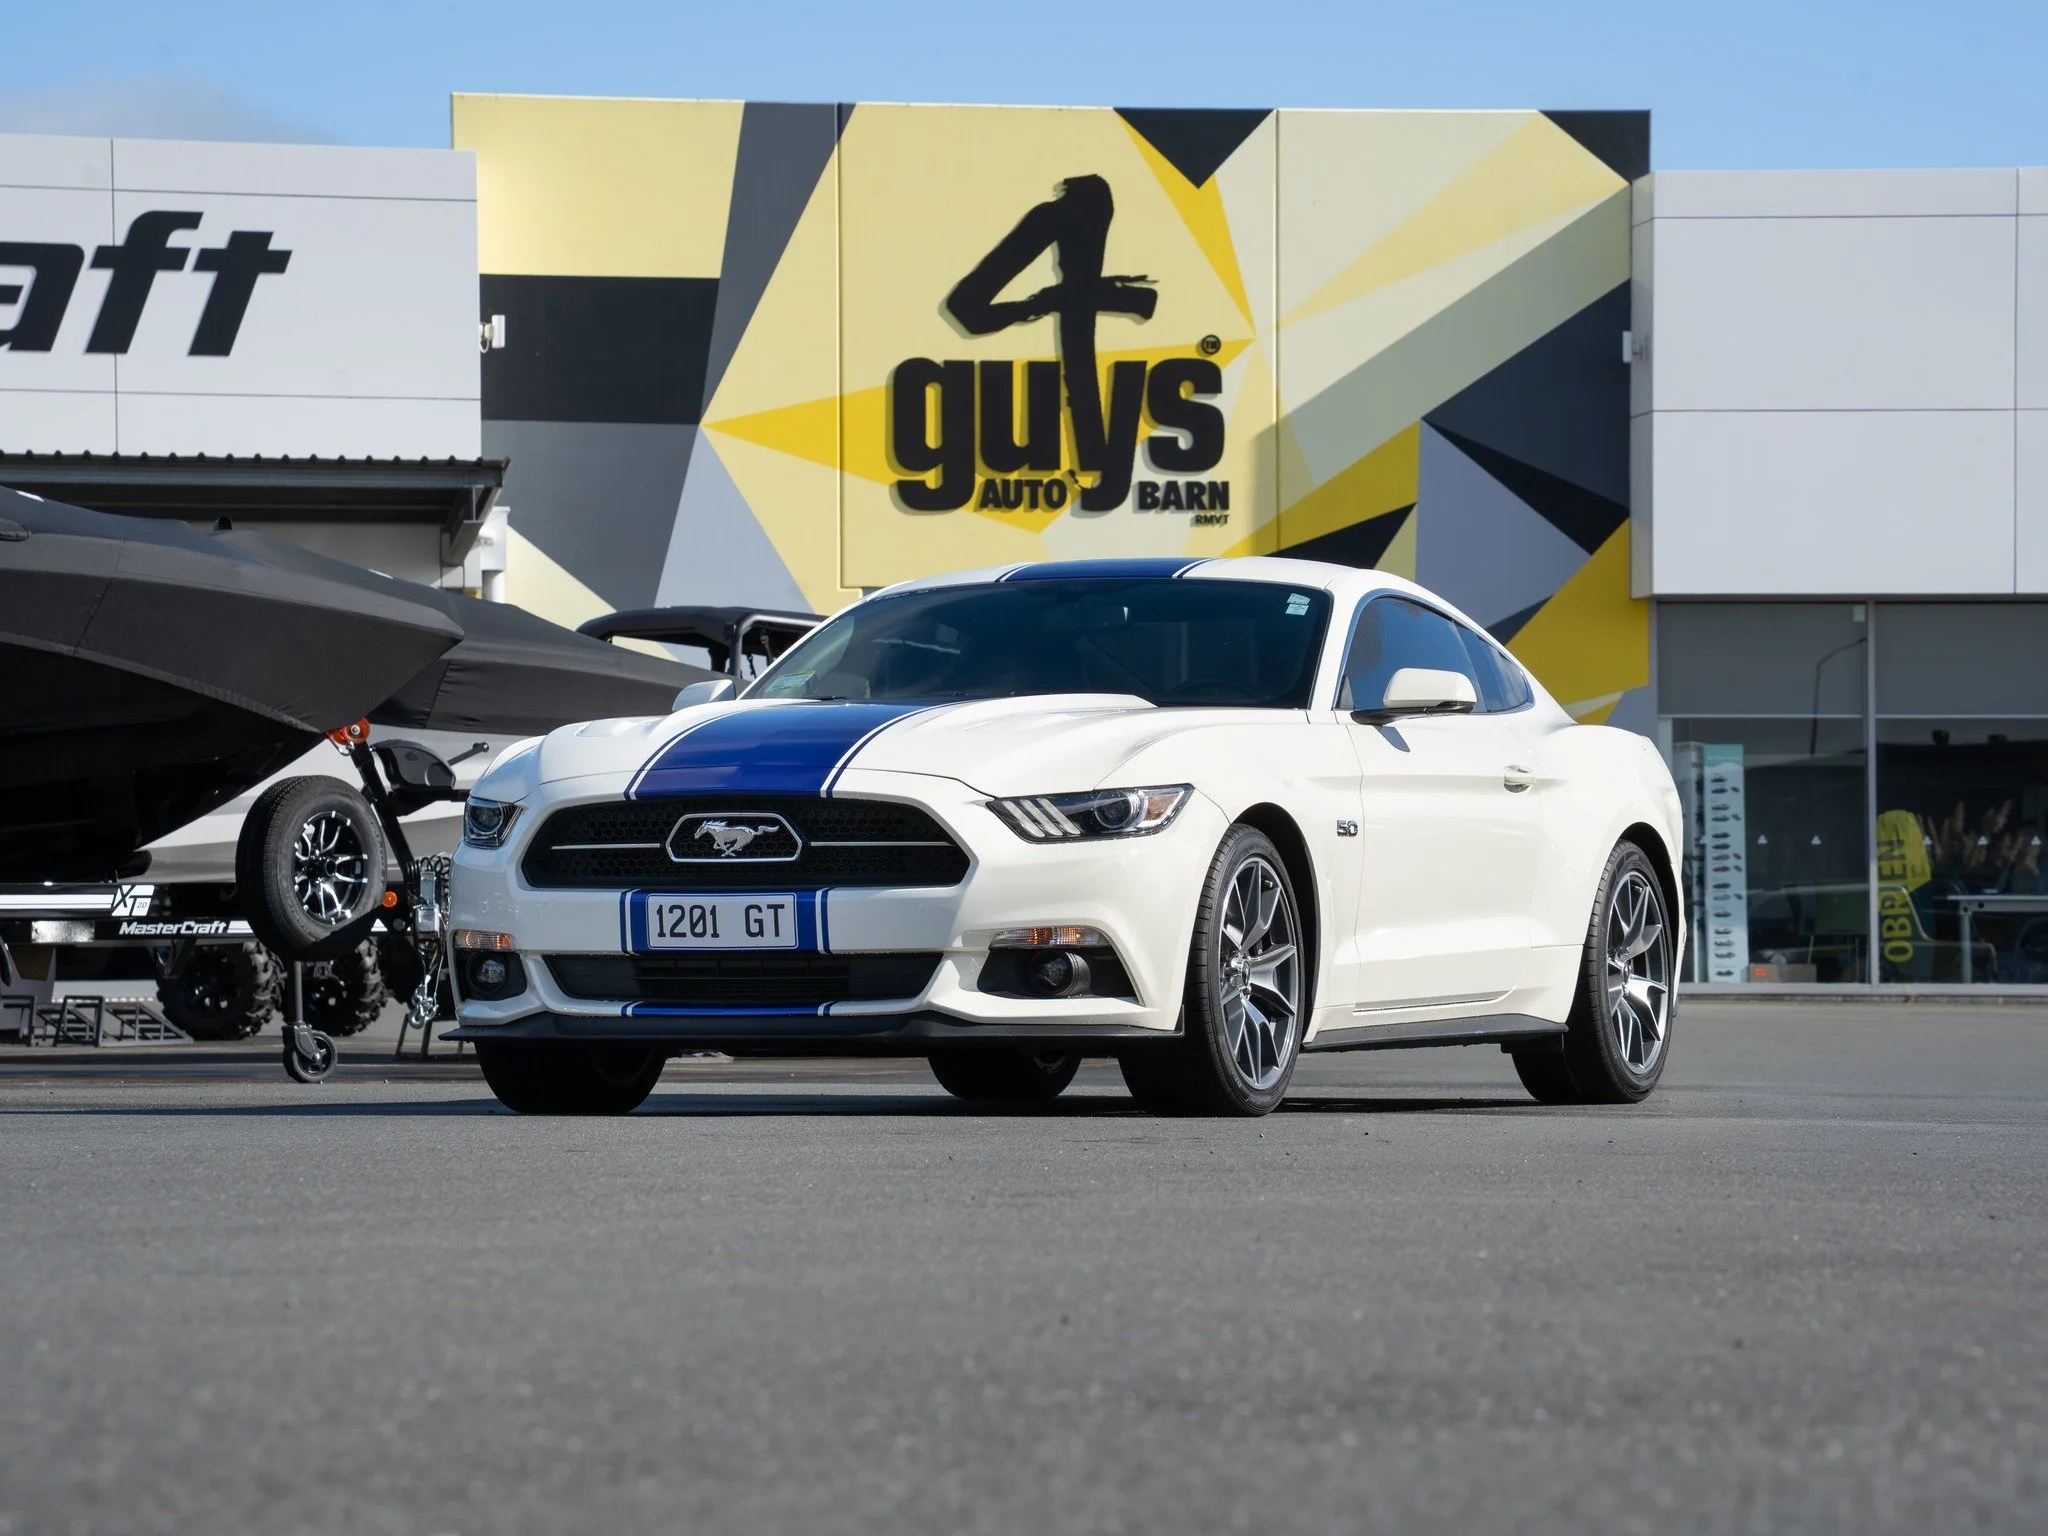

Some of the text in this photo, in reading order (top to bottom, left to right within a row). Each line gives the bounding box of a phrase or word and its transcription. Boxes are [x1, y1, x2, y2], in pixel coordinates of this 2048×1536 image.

[946, 173, 1160, 460] 4
[892, 356, 1225, 512] guys
[979, 478, 1230, 511] AUTO BARN
[1195, 514, 1230, 525] RMVT
[111, 884, 155, 916] XT
[119, 921, 227, 935] MasterCraft
[656, 903, 786, 938] 1201 GT
